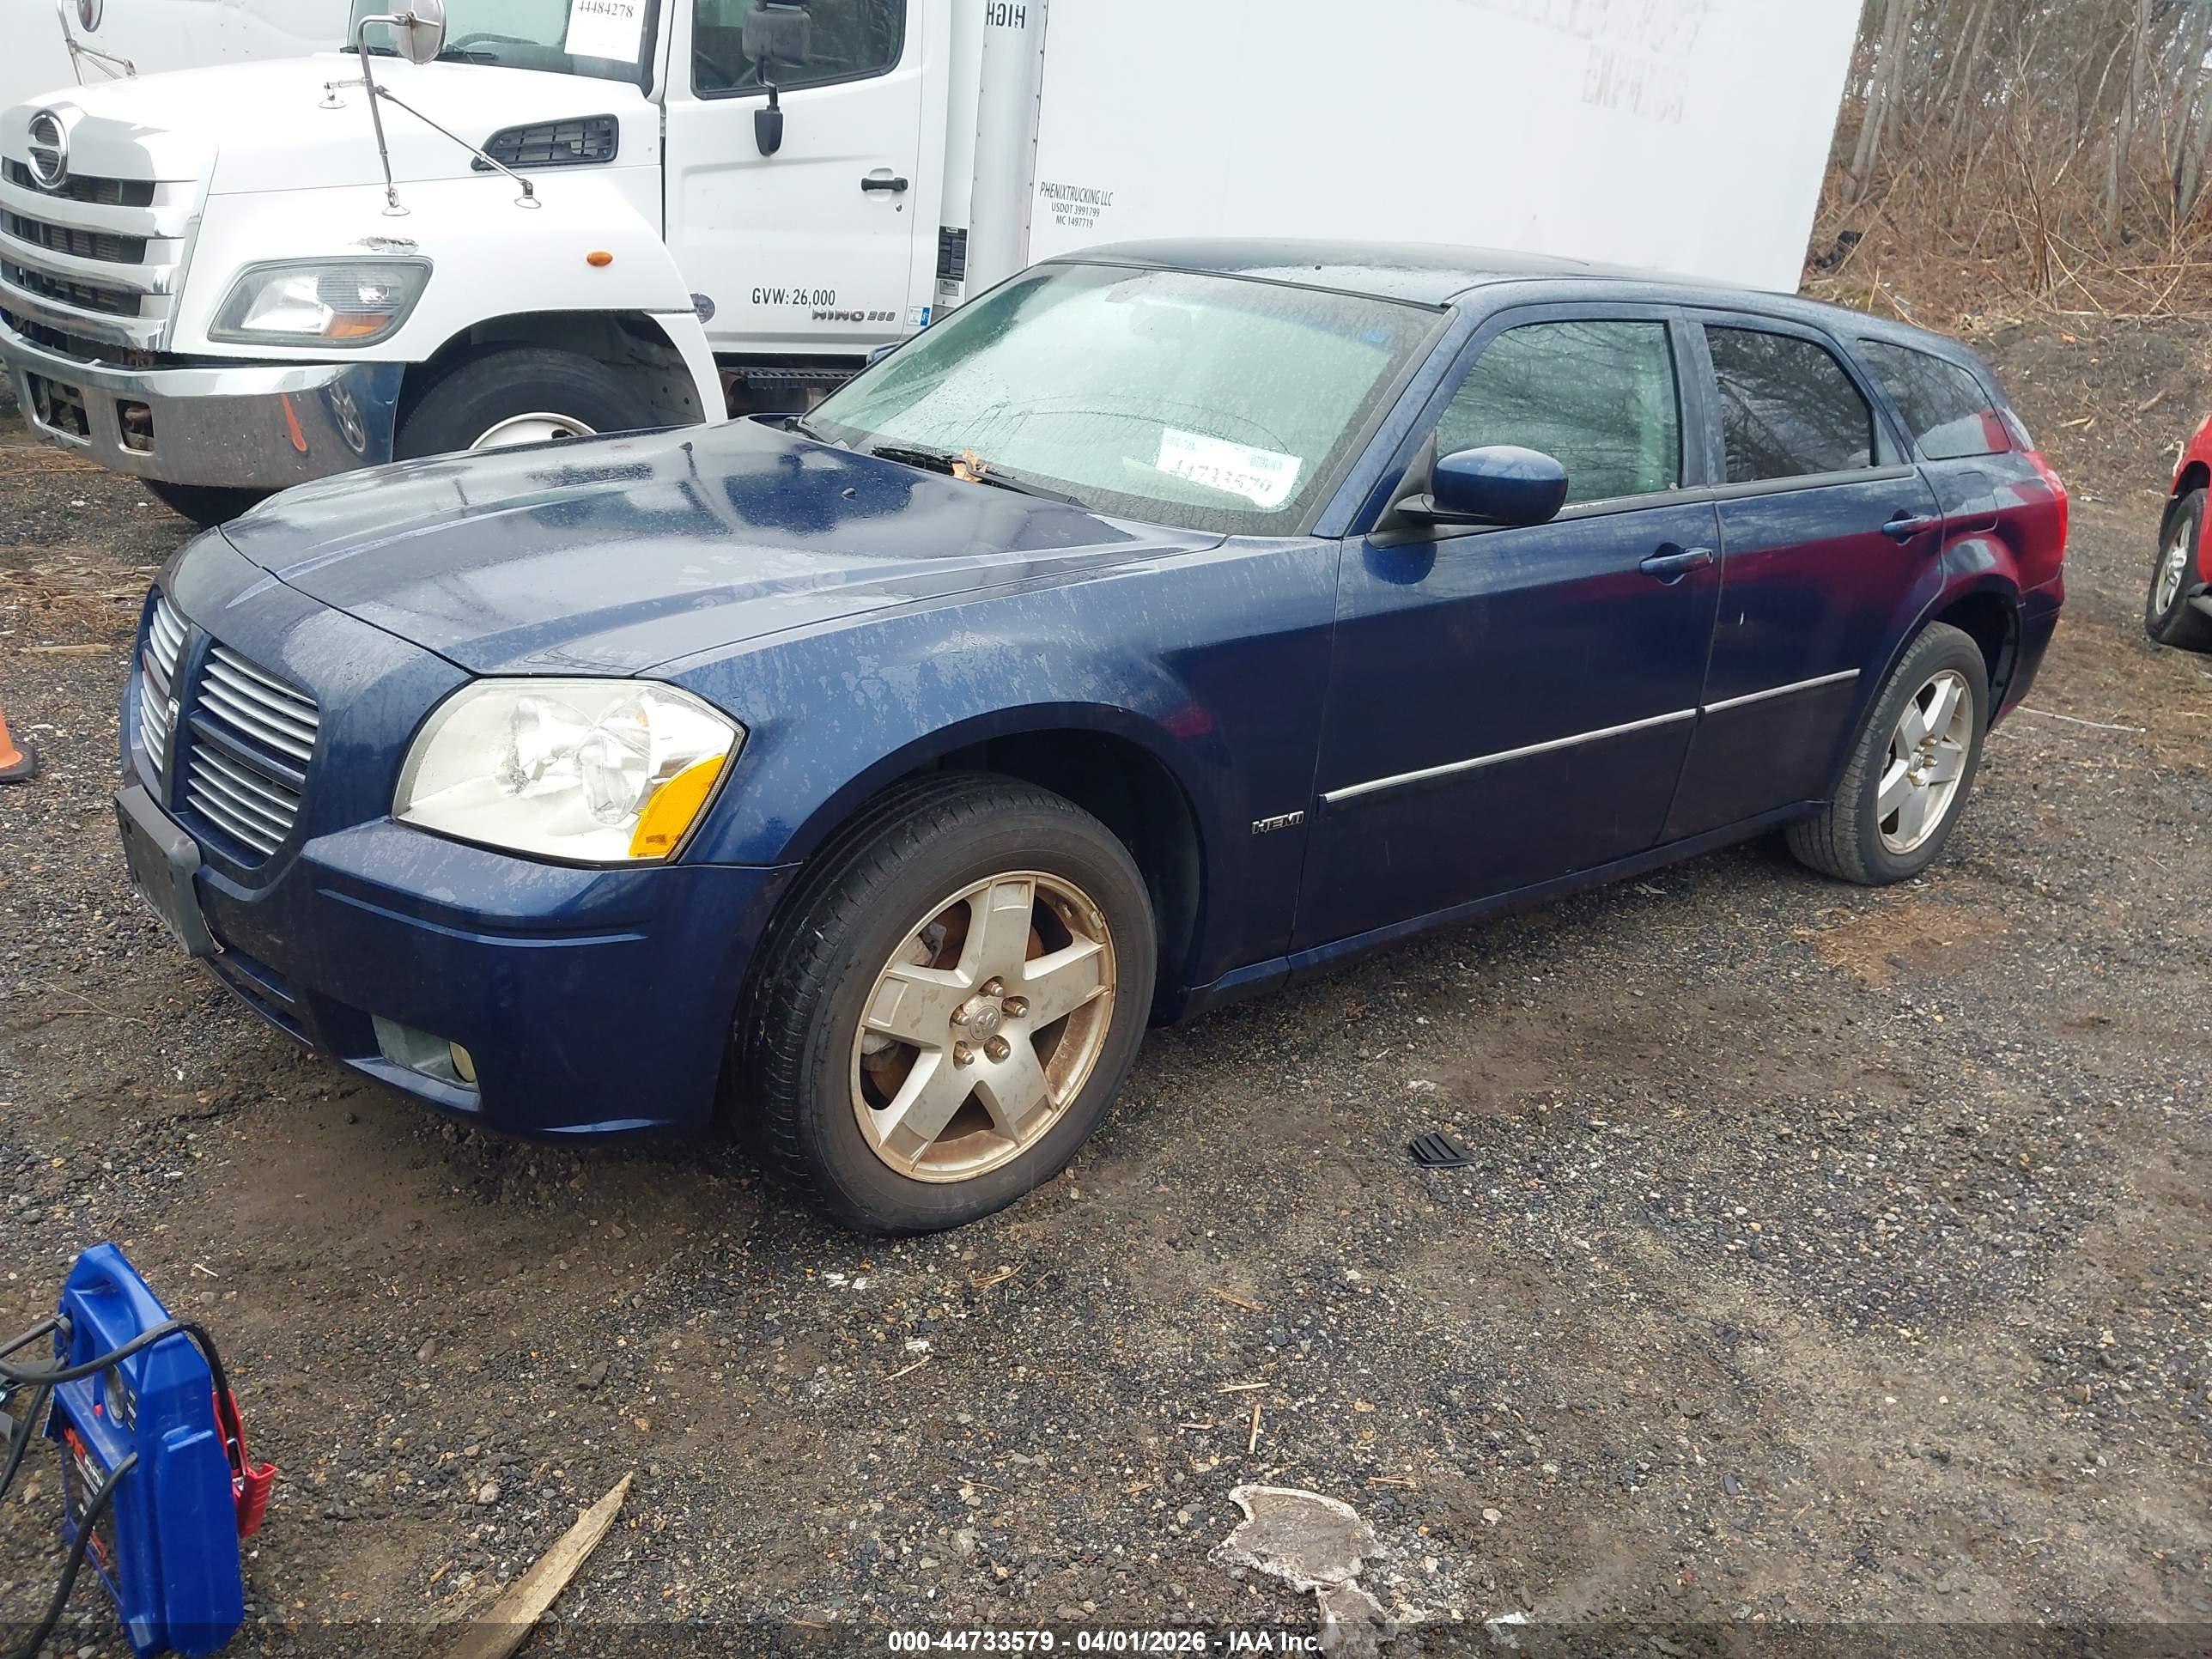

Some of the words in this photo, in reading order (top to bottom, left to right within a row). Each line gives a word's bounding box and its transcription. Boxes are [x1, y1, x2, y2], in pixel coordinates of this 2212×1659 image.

[578, 0, 634, 18] 44484278
[1039, 181, 1100, 205] PHENIXTRUCKING
[1100, 191, 1114, 207] LLC
[1051, 202, 1073, 214] USDOT
[1074, 205, 1100, 217] 3991799
[1055, 215, 1066, 225] MC
[1067, 216, 1094, 228] 1497719
[752, 288, 789, 305] GVW:
[792, 289, 836, 308] 26,000
[811, 309, 865, 322] HINO
[1251, 811, 1304, 835] HEMI
